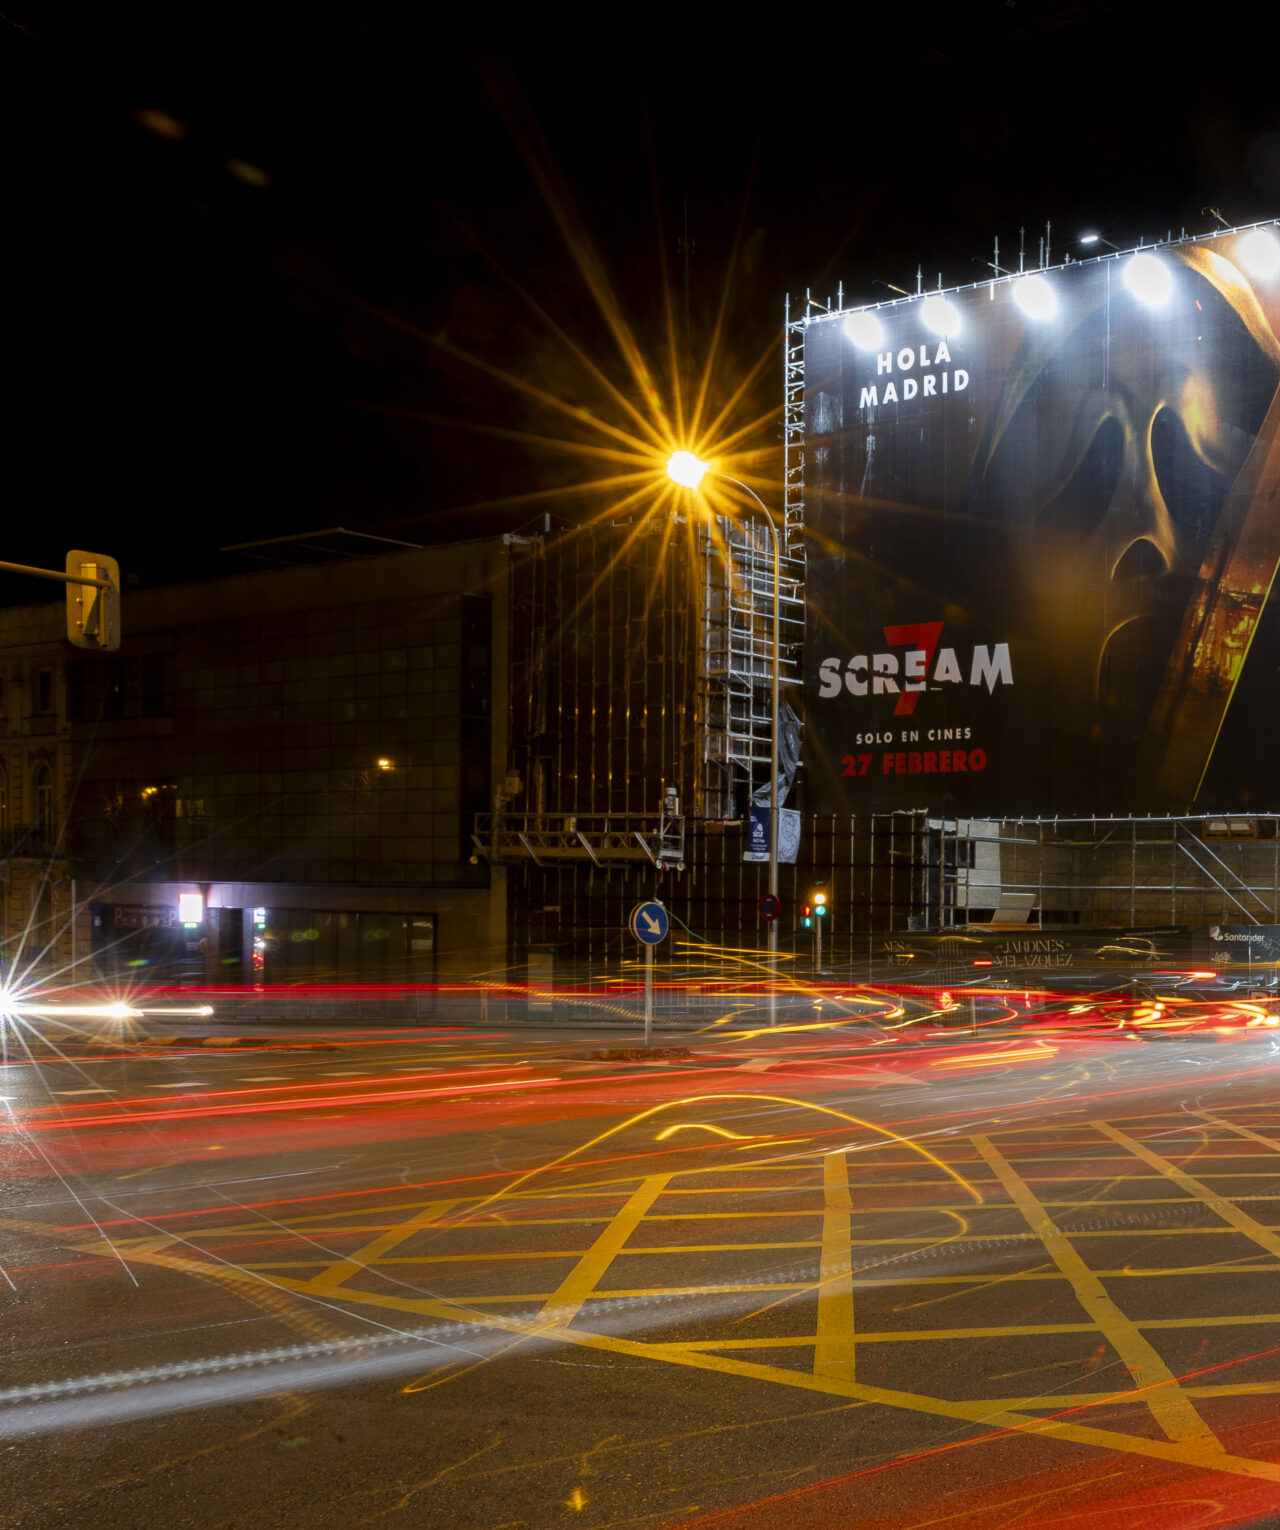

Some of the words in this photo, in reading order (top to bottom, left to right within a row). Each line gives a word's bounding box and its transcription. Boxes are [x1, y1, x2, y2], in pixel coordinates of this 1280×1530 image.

[877, 341, 951, 375] HOLA
[859, 369, 969, 409] MADRID
[818, 642, 1014, 698] SCREAM
[882, 621, 945, 716] 7
[855, 731, 893, 745] SOLO
[901, 730, 919, 742] EN
[927, 727, 972, 741] CINES
[841, 753, 874, 777] 27
[882, 748, 988, 776] FEBRERO
[1002, 939, 1064, 953] JARDINES
[1224, 932, 1265, 942] Santander
